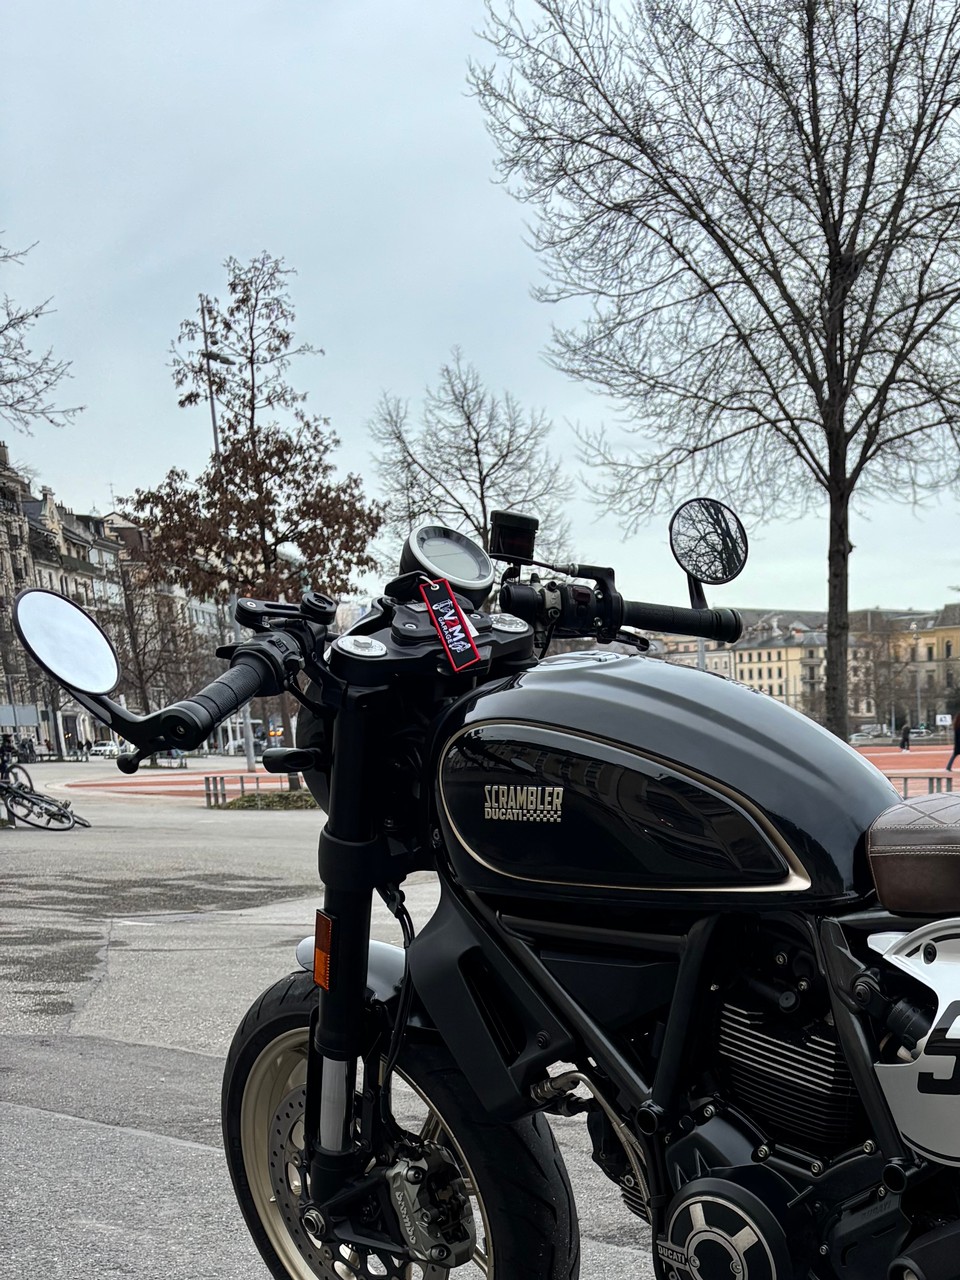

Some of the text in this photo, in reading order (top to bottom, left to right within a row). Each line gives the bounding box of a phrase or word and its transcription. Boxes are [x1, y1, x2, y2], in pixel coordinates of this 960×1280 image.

[437, 616, 455, 644] GARAGE
[484, 785, 564, 811] SCRAMBLER
[484, 808, 523, 821] DUCATI
[657, 1244, 686, 1264] DUCATI
